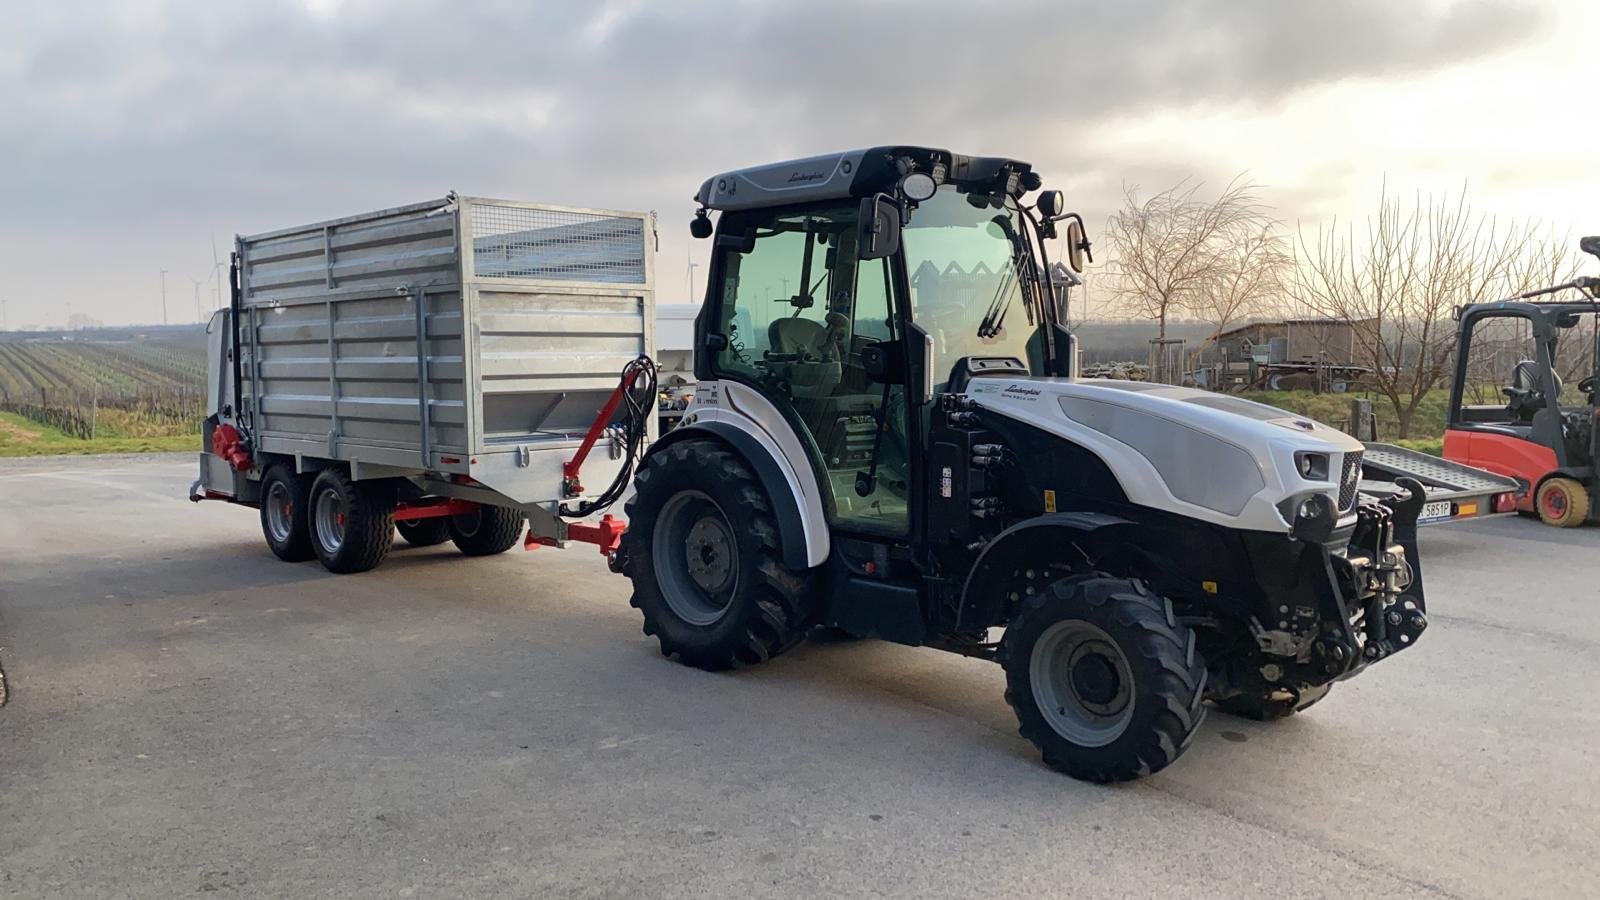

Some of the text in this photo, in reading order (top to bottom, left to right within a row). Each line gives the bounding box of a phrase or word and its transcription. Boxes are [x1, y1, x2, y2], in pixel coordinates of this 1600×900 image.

[787, 171, 824, 183] Lamborghini
[1004, 384, 1041, 396] Lamborghini
[1426, 502, 1449, 517] 5851P
